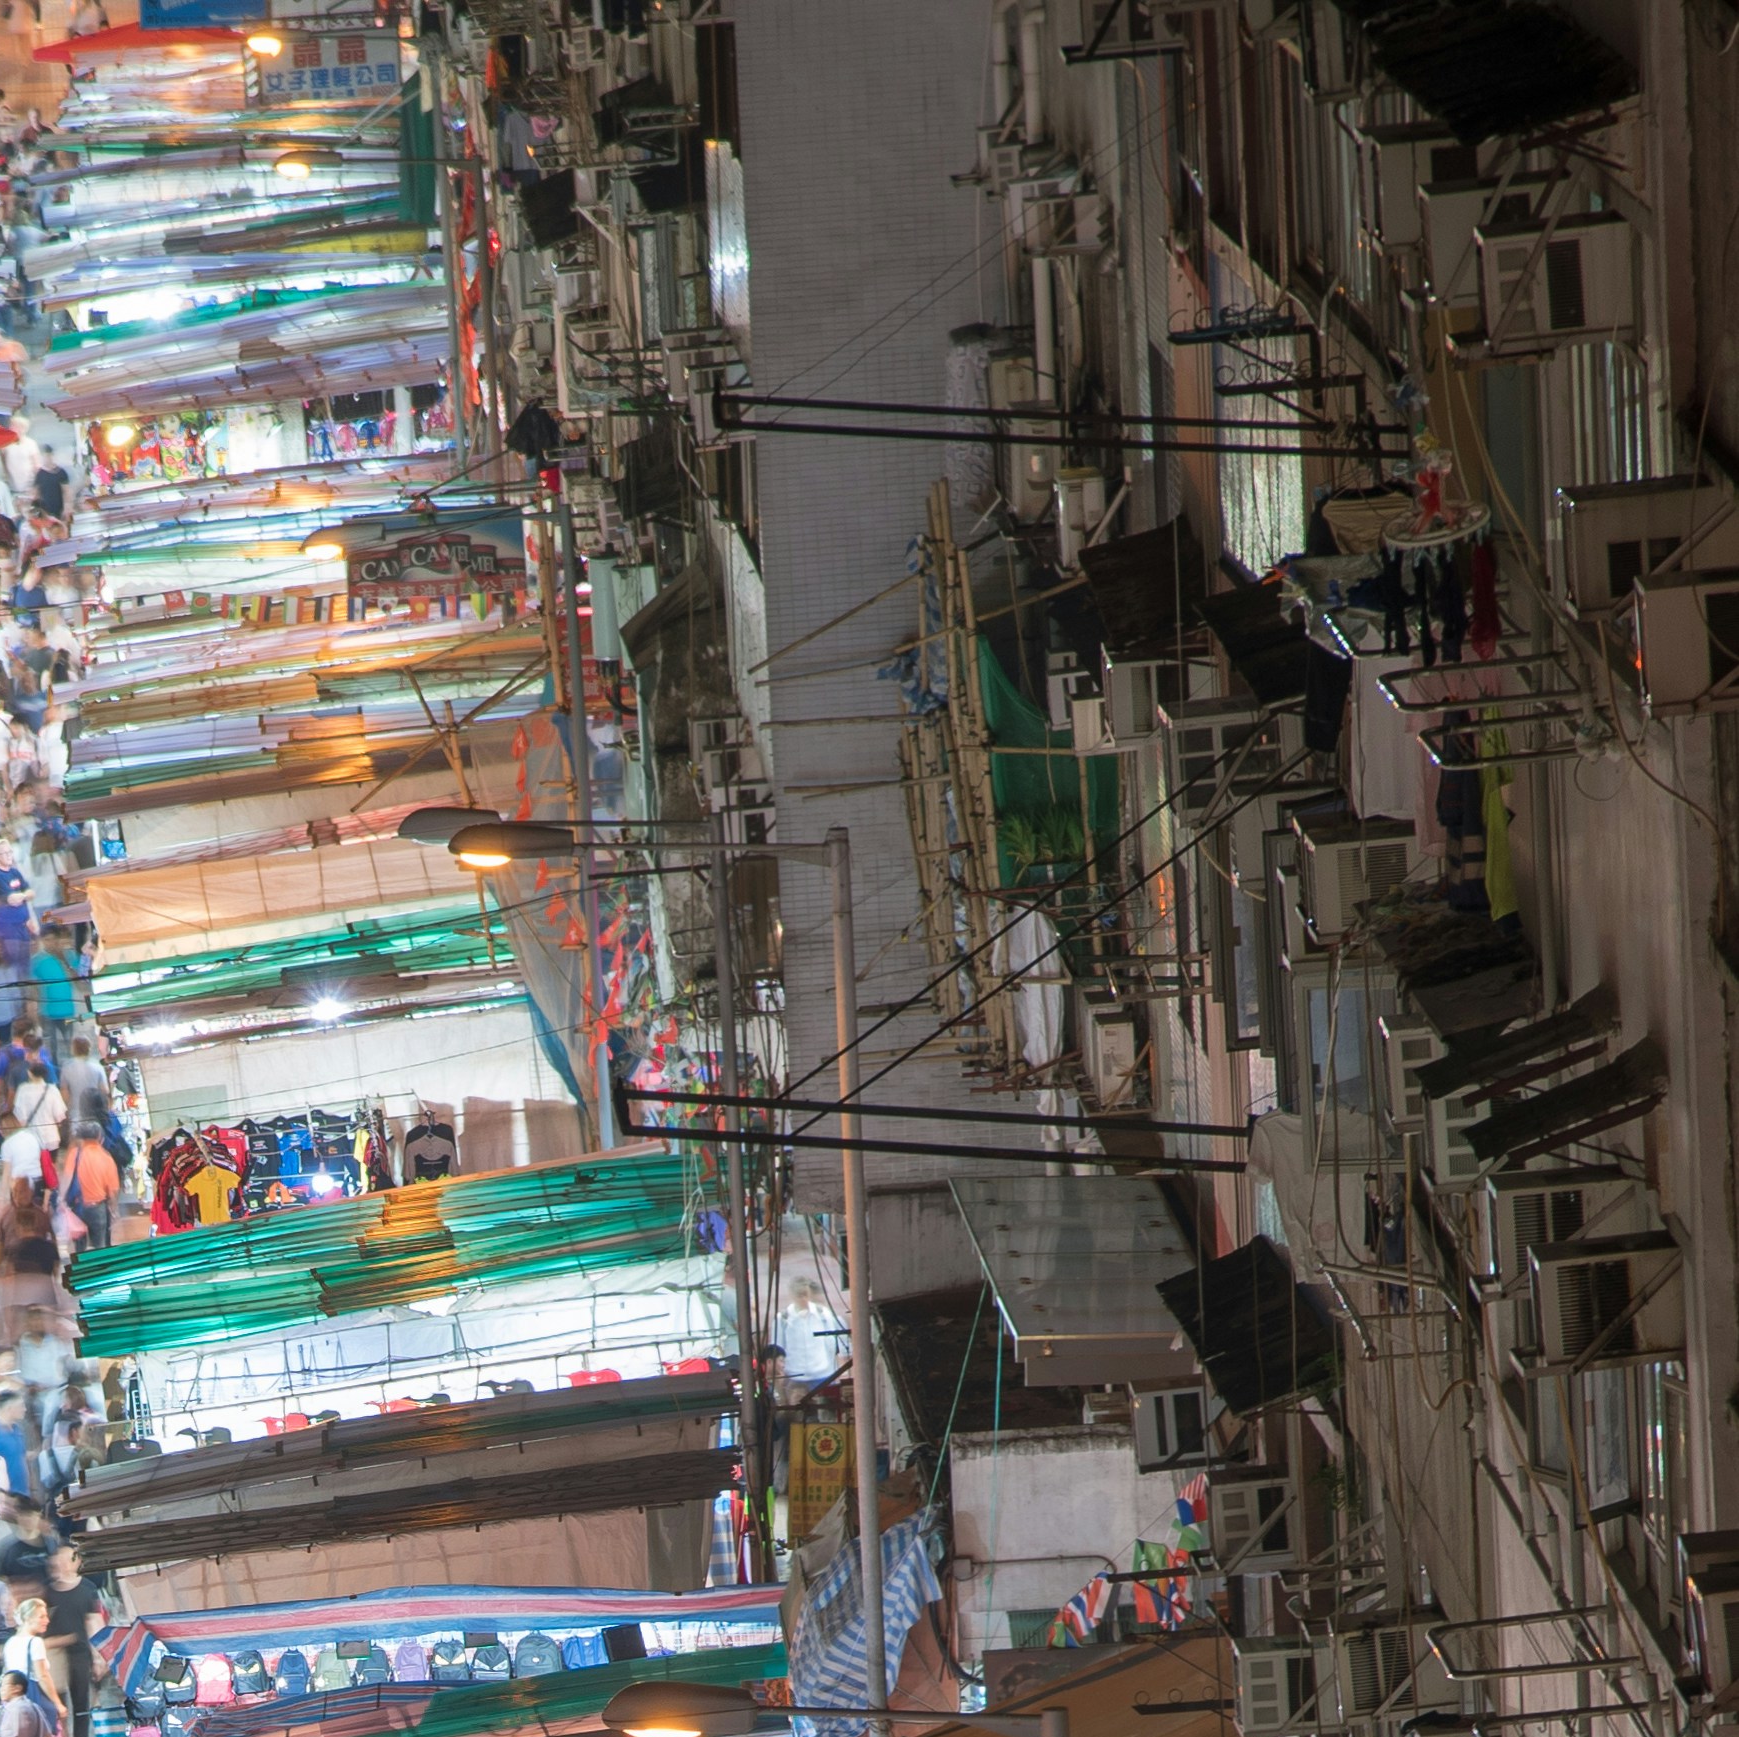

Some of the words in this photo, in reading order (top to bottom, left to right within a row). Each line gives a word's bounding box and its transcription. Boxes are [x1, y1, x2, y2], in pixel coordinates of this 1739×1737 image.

[265, 63, 397, 93] 女子理髮公司
